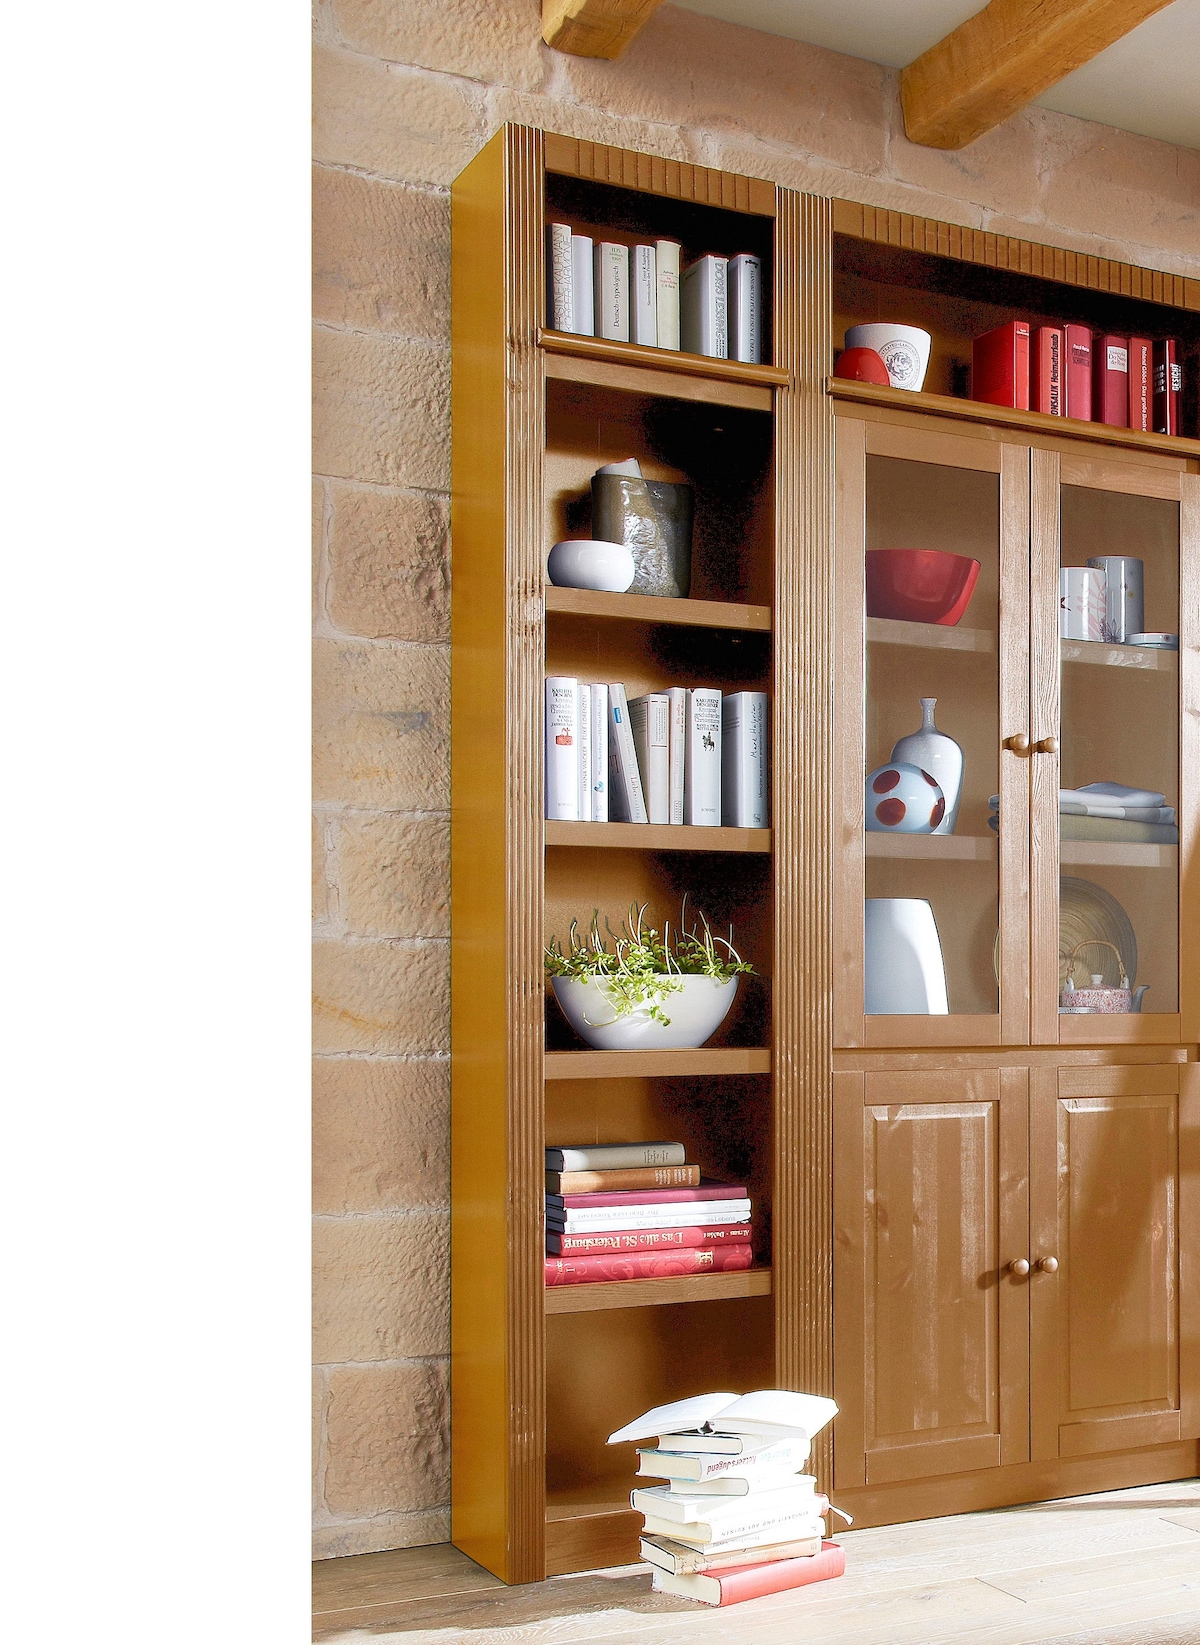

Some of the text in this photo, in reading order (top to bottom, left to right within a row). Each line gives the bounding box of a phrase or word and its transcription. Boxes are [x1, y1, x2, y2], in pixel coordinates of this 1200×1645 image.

[613, 265, 621, 299] typologisch
[1050, 333, 1059, 384] Heimaturlaub
[563, 1231, 684, 1250] Das alte St. Petersburg
[706, 1460, 732, 1476] Jugend
